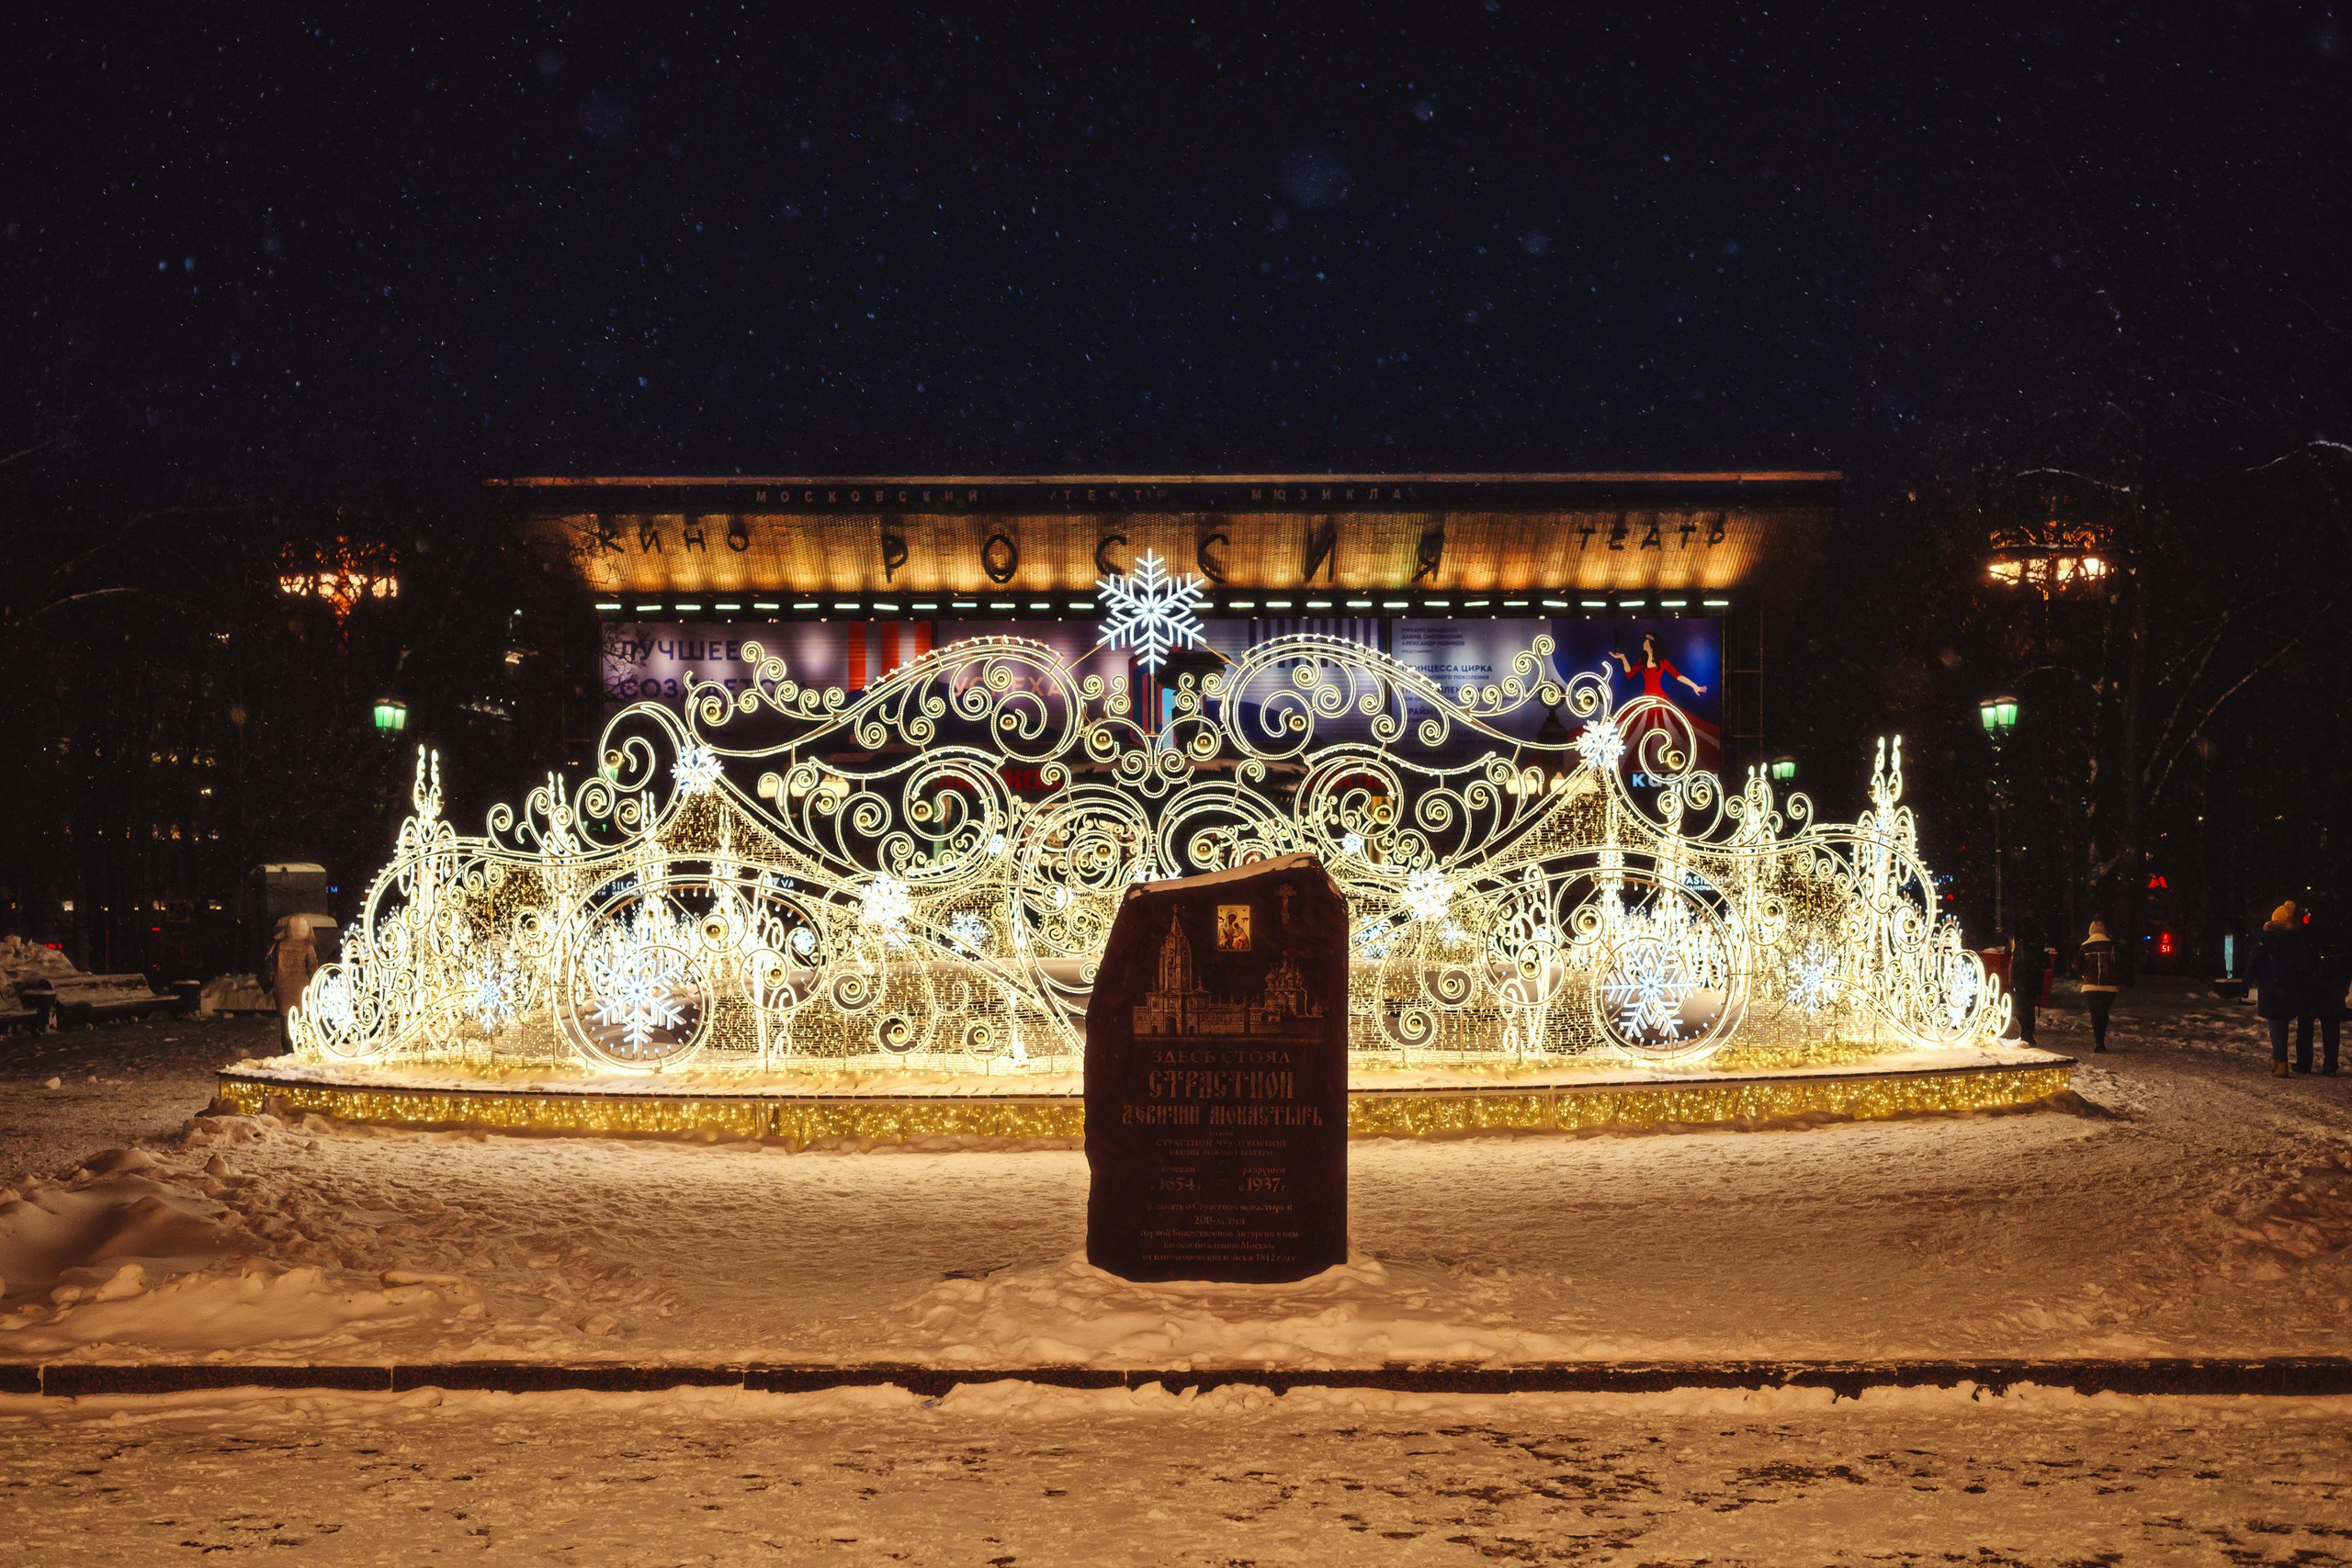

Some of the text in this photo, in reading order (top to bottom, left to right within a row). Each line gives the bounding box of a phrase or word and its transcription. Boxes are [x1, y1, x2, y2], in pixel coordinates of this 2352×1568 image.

[755, 490, 978, 502] МОСКОВСКИЙ
[1250, 487, 1403, 502] МЮЗИКЛА
[597, 528, 750, 554] КИНО
[1578, 525, 1725, 551] ТЕАТР
[620, 640, 741, 662] ЛУЧШЕЕ
[1151, 1051, 1291, 1065] ЗДЕСЬ СТОЯЛ
[1148, 1068, 1294, 1100] СТРАСТНОЙ
[1159, 1177, 1195, 1191] 1654
[1248, 1177, 1282, 1192] 1937
[1255, 1253, 1275, 1262] 1812
